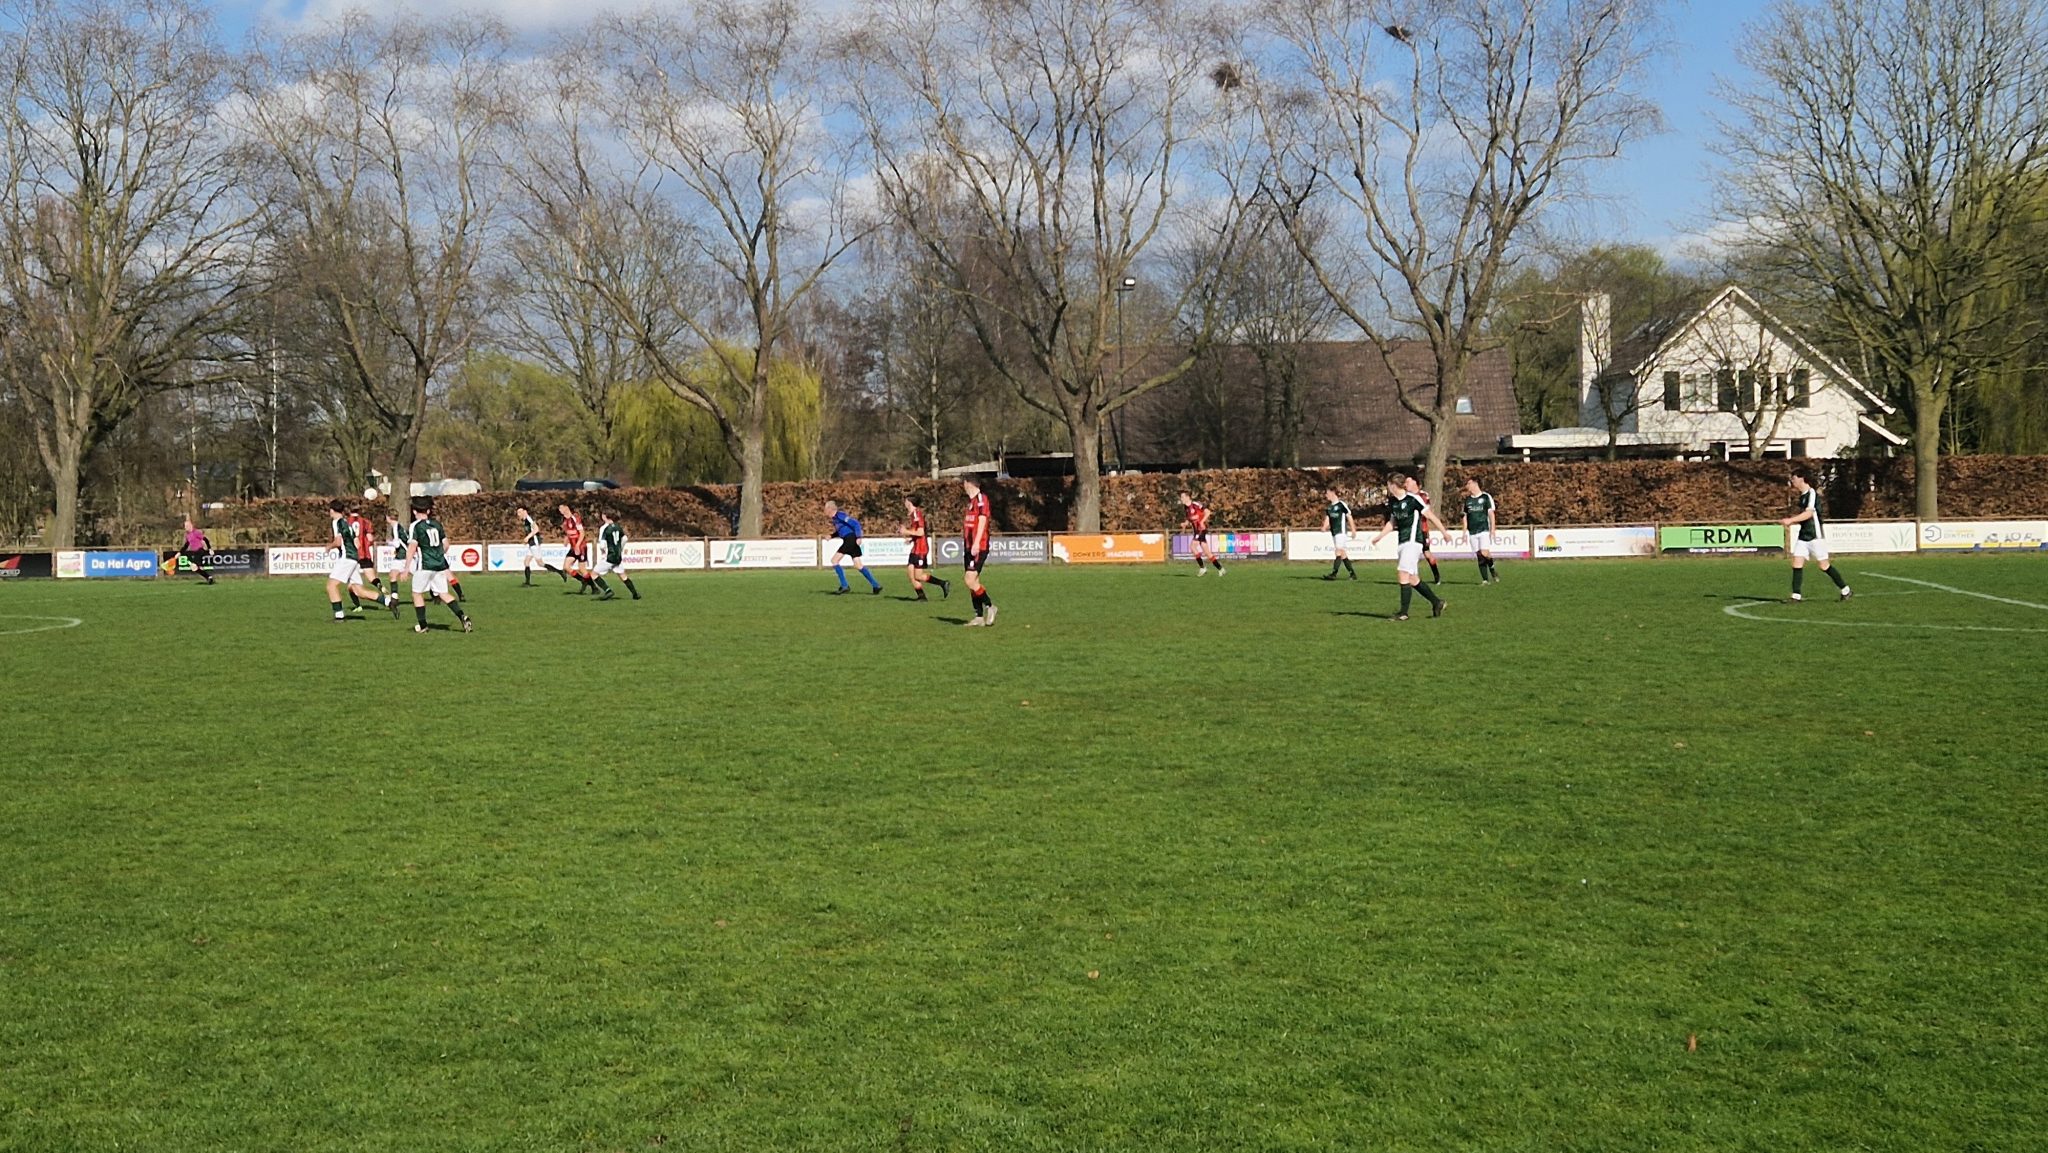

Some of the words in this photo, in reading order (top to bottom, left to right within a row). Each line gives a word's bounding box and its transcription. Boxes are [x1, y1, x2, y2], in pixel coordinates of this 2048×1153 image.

[426, 528, 440, 547] 10
[1703, 528, 1752, 544] RDM
[1009, 540, 1043, 550] ELZEN
[126, 560, 151, 572] Agro
[273, 562, 325, 570] SUPERSTORE
